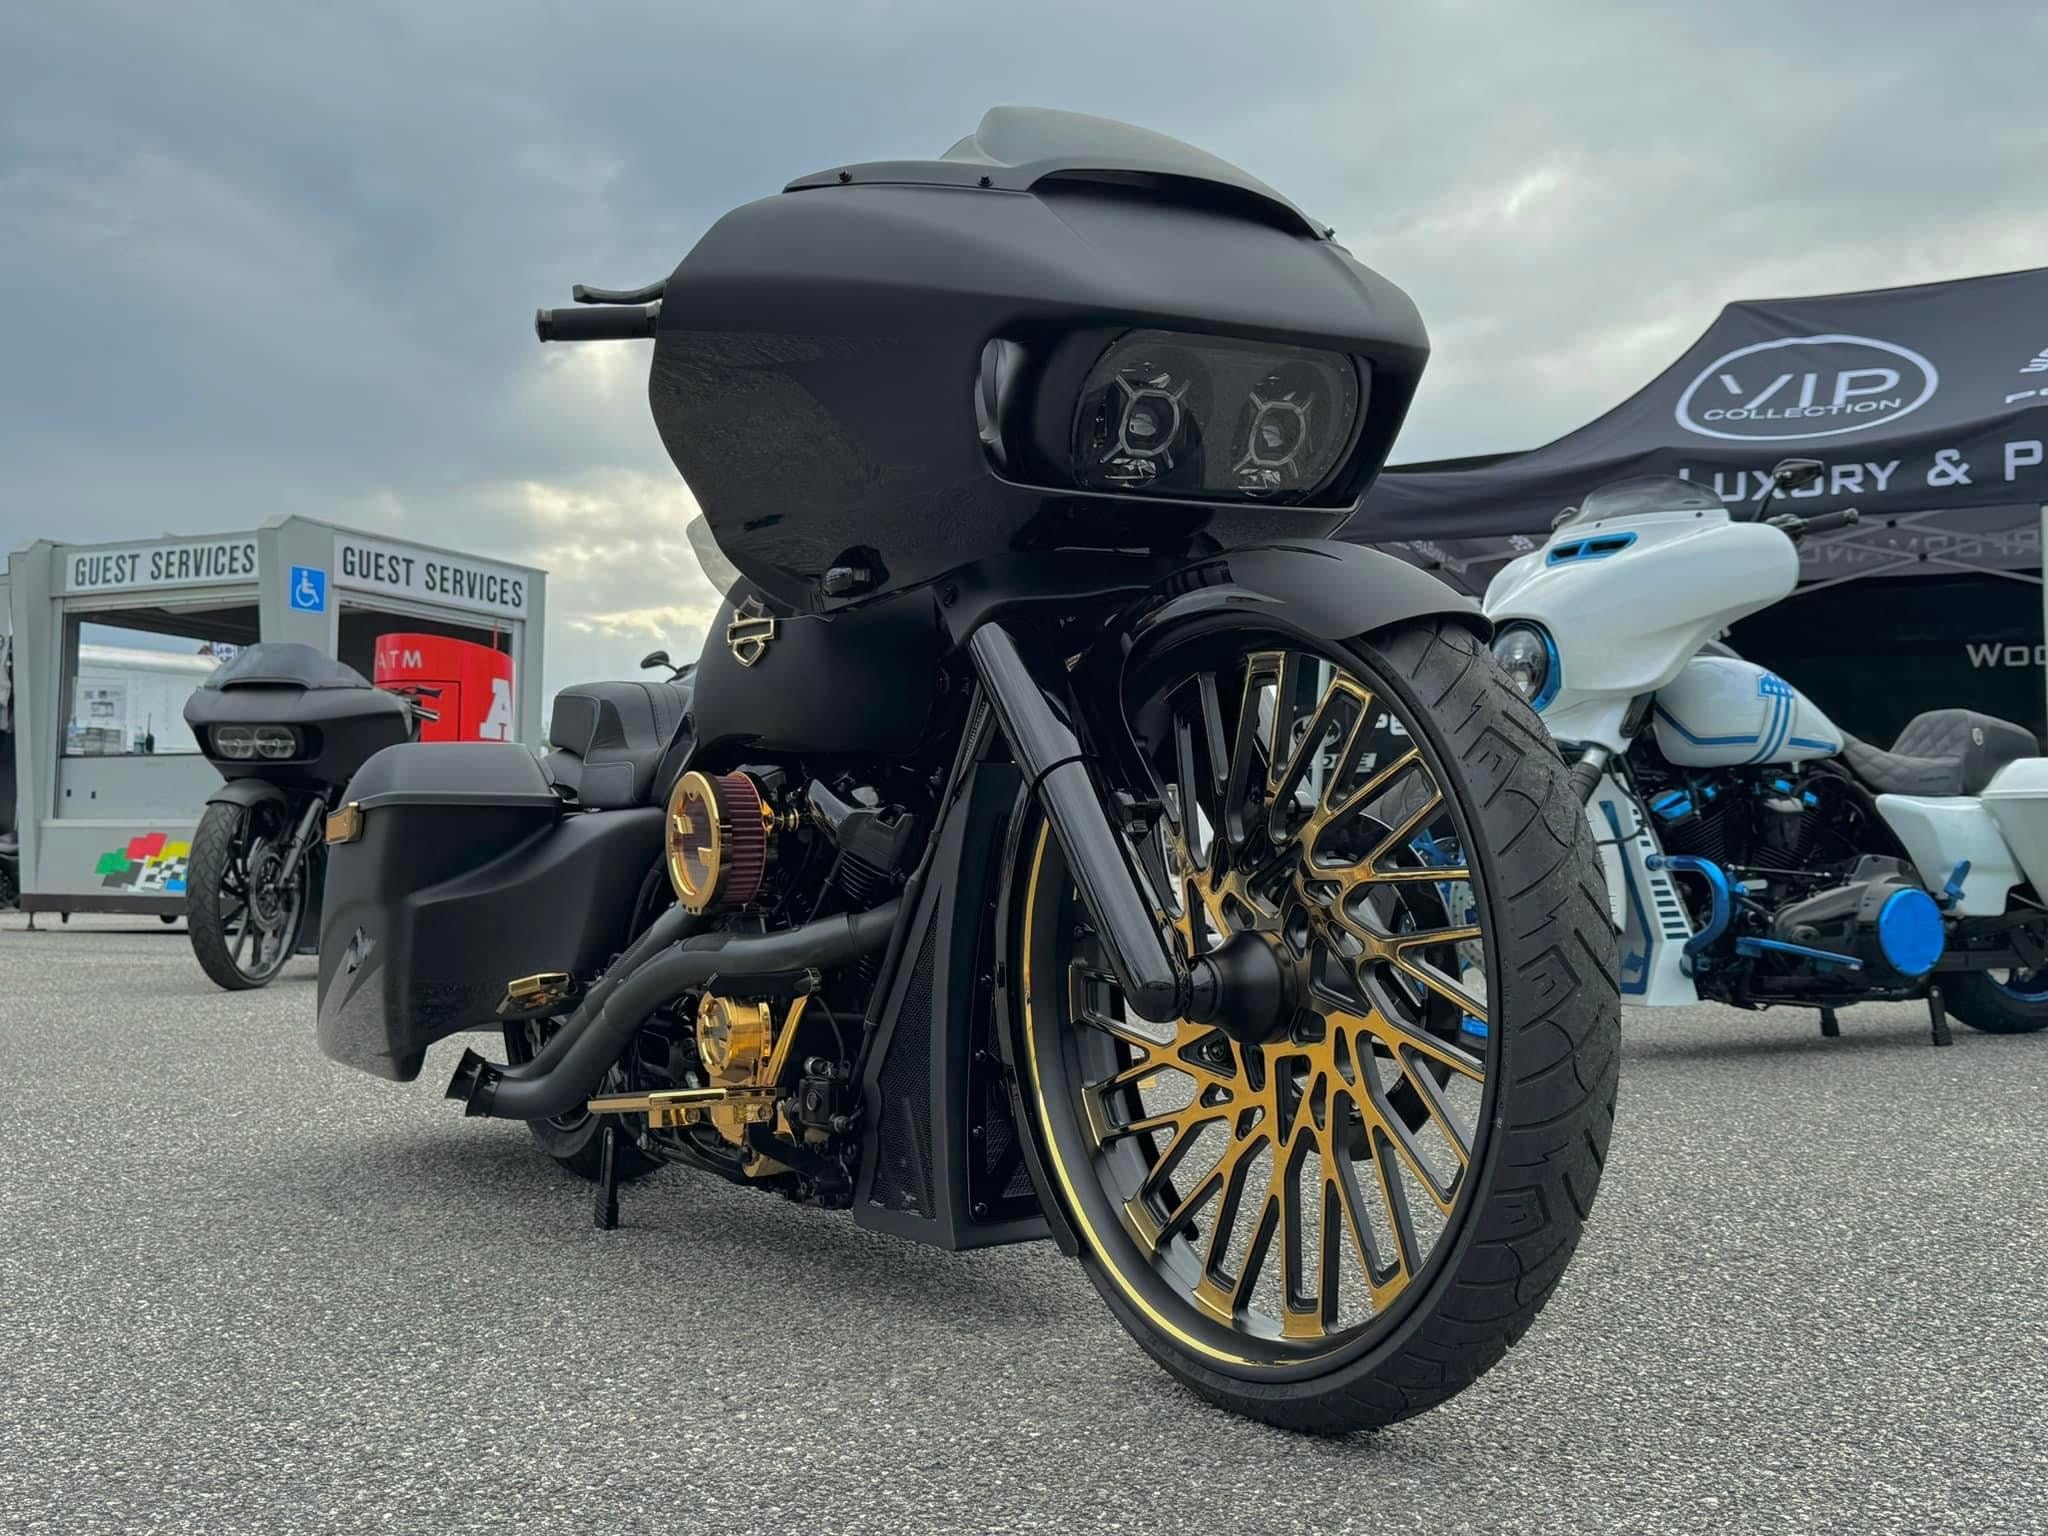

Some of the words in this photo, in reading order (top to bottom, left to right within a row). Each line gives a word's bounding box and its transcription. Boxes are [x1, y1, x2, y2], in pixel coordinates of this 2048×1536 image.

[1720, 368, 1900, 409] VIP
[1703, 399, 1901, 421] COLLECTION
[1926, 449, 1972, 486] &
[74, 554, 140, 586] GUEST
[150, 544, 255, 580] SERVICES
[343, 547, 414, 587] GUEST
[425, 563, 523, 608] SERVICES
[378, 649, 423, 669] ATM
